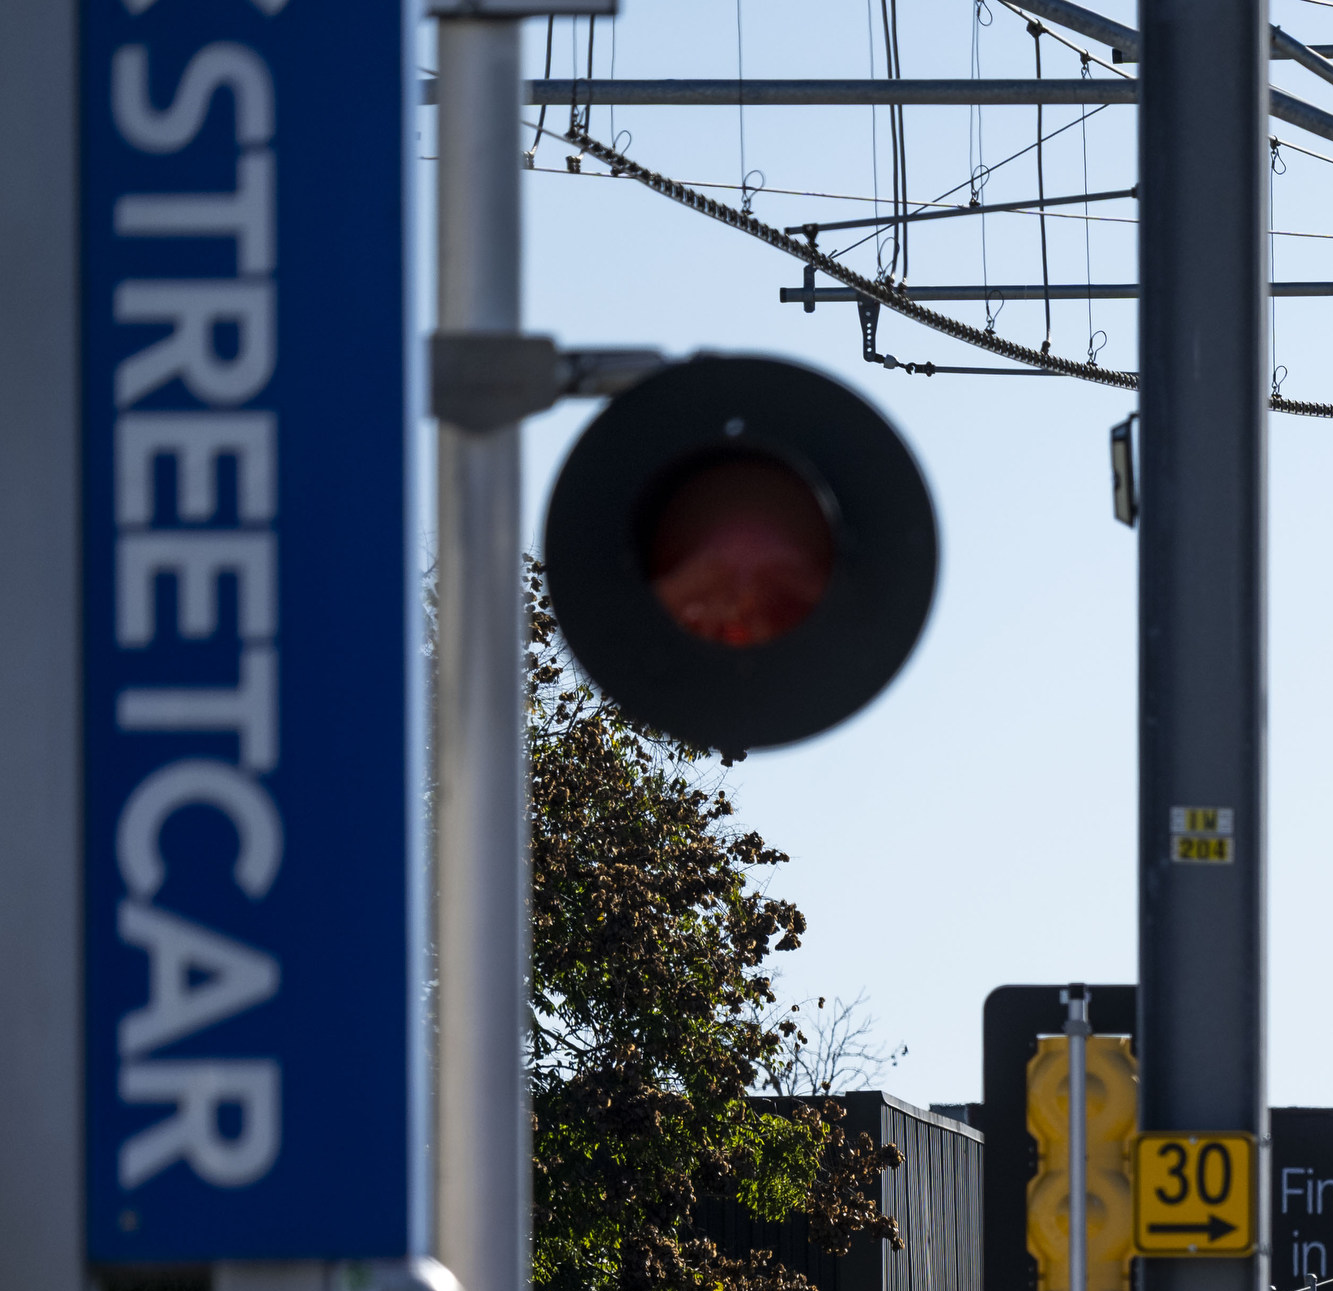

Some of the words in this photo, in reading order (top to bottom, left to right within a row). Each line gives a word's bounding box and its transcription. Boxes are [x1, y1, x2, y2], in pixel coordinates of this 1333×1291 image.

[110, 40, 285, 1191] STREETCAR
[1179, 837, 1225, 860] 204
[1155, 1142, 1233, 1207] 30
[1291, 1229, 1327, 1279] in
